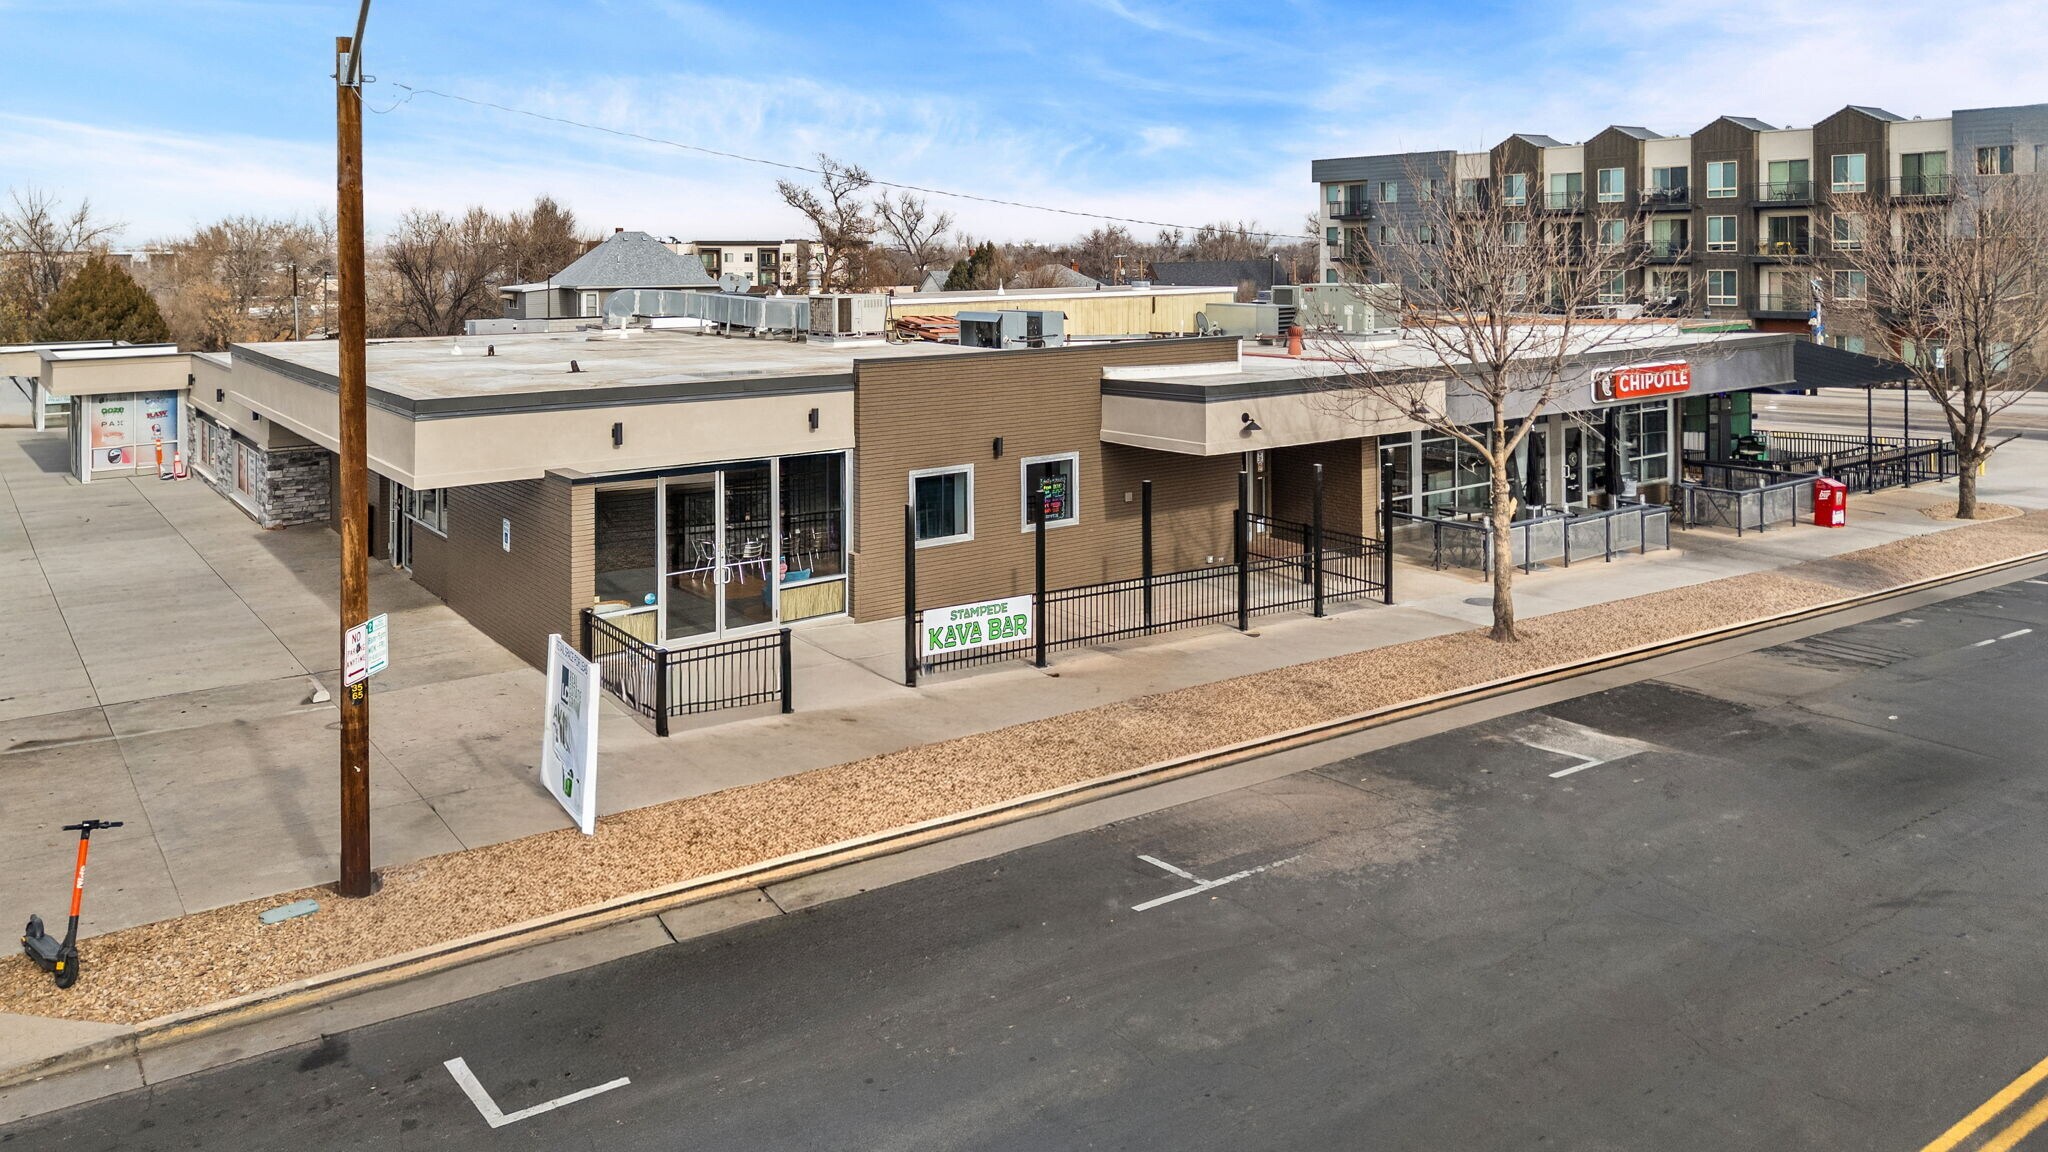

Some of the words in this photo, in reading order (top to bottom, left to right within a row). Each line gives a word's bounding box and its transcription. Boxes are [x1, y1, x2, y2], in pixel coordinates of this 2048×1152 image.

[1620, 369, 1688, 392] CHIPOTLE
[146, 409, 168, 419] RAW
[950, 602, 1008, 621] STAMPEDE
[351, 631, 361, 645] NO
[928, 621, 982, 650] KAVA
[988, 613, 1028, 641] BAR
[351, 683, 363, 692] 35
[352, 691, 363, 700] 65
